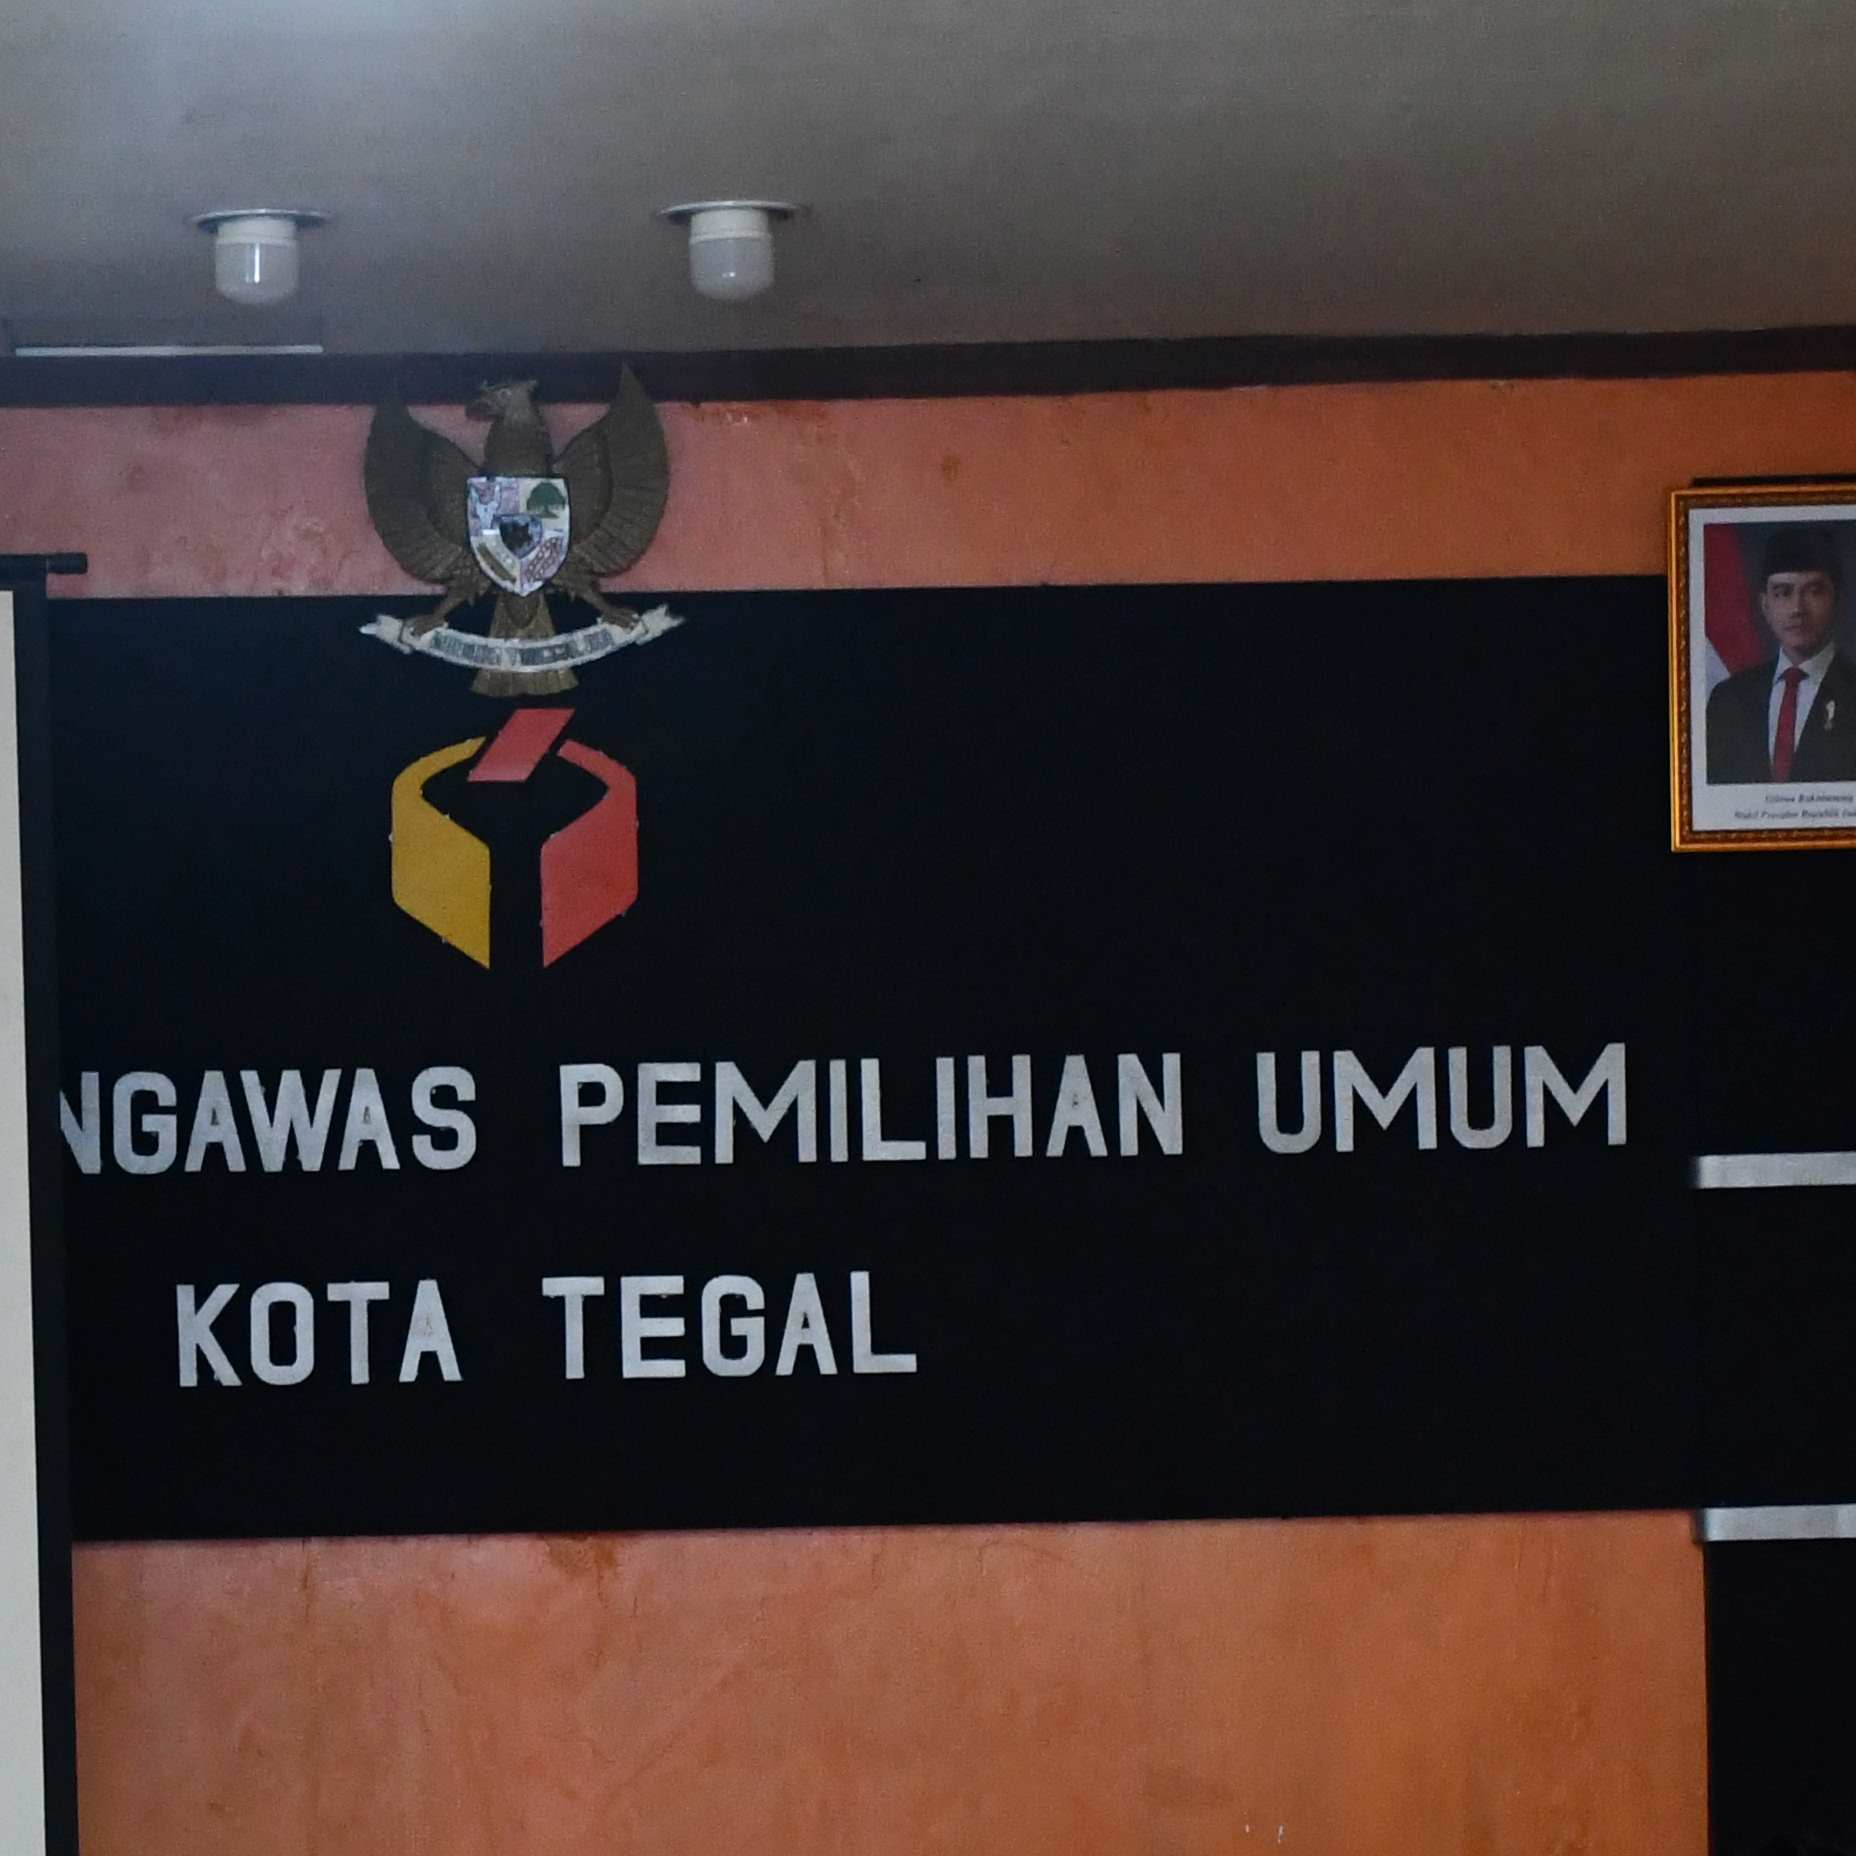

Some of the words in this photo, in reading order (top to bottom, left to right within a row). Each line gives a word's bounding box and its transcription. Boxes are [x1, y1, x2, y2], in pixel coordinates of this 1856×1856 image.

[559, 1052, 1183, 1167] PEMILIHAN
[1256, 1042, 1627, 1154] UMUM
[176, 1279, 463, 1388] KOTA
[541, 1270, 918, 1379] TEGAL
